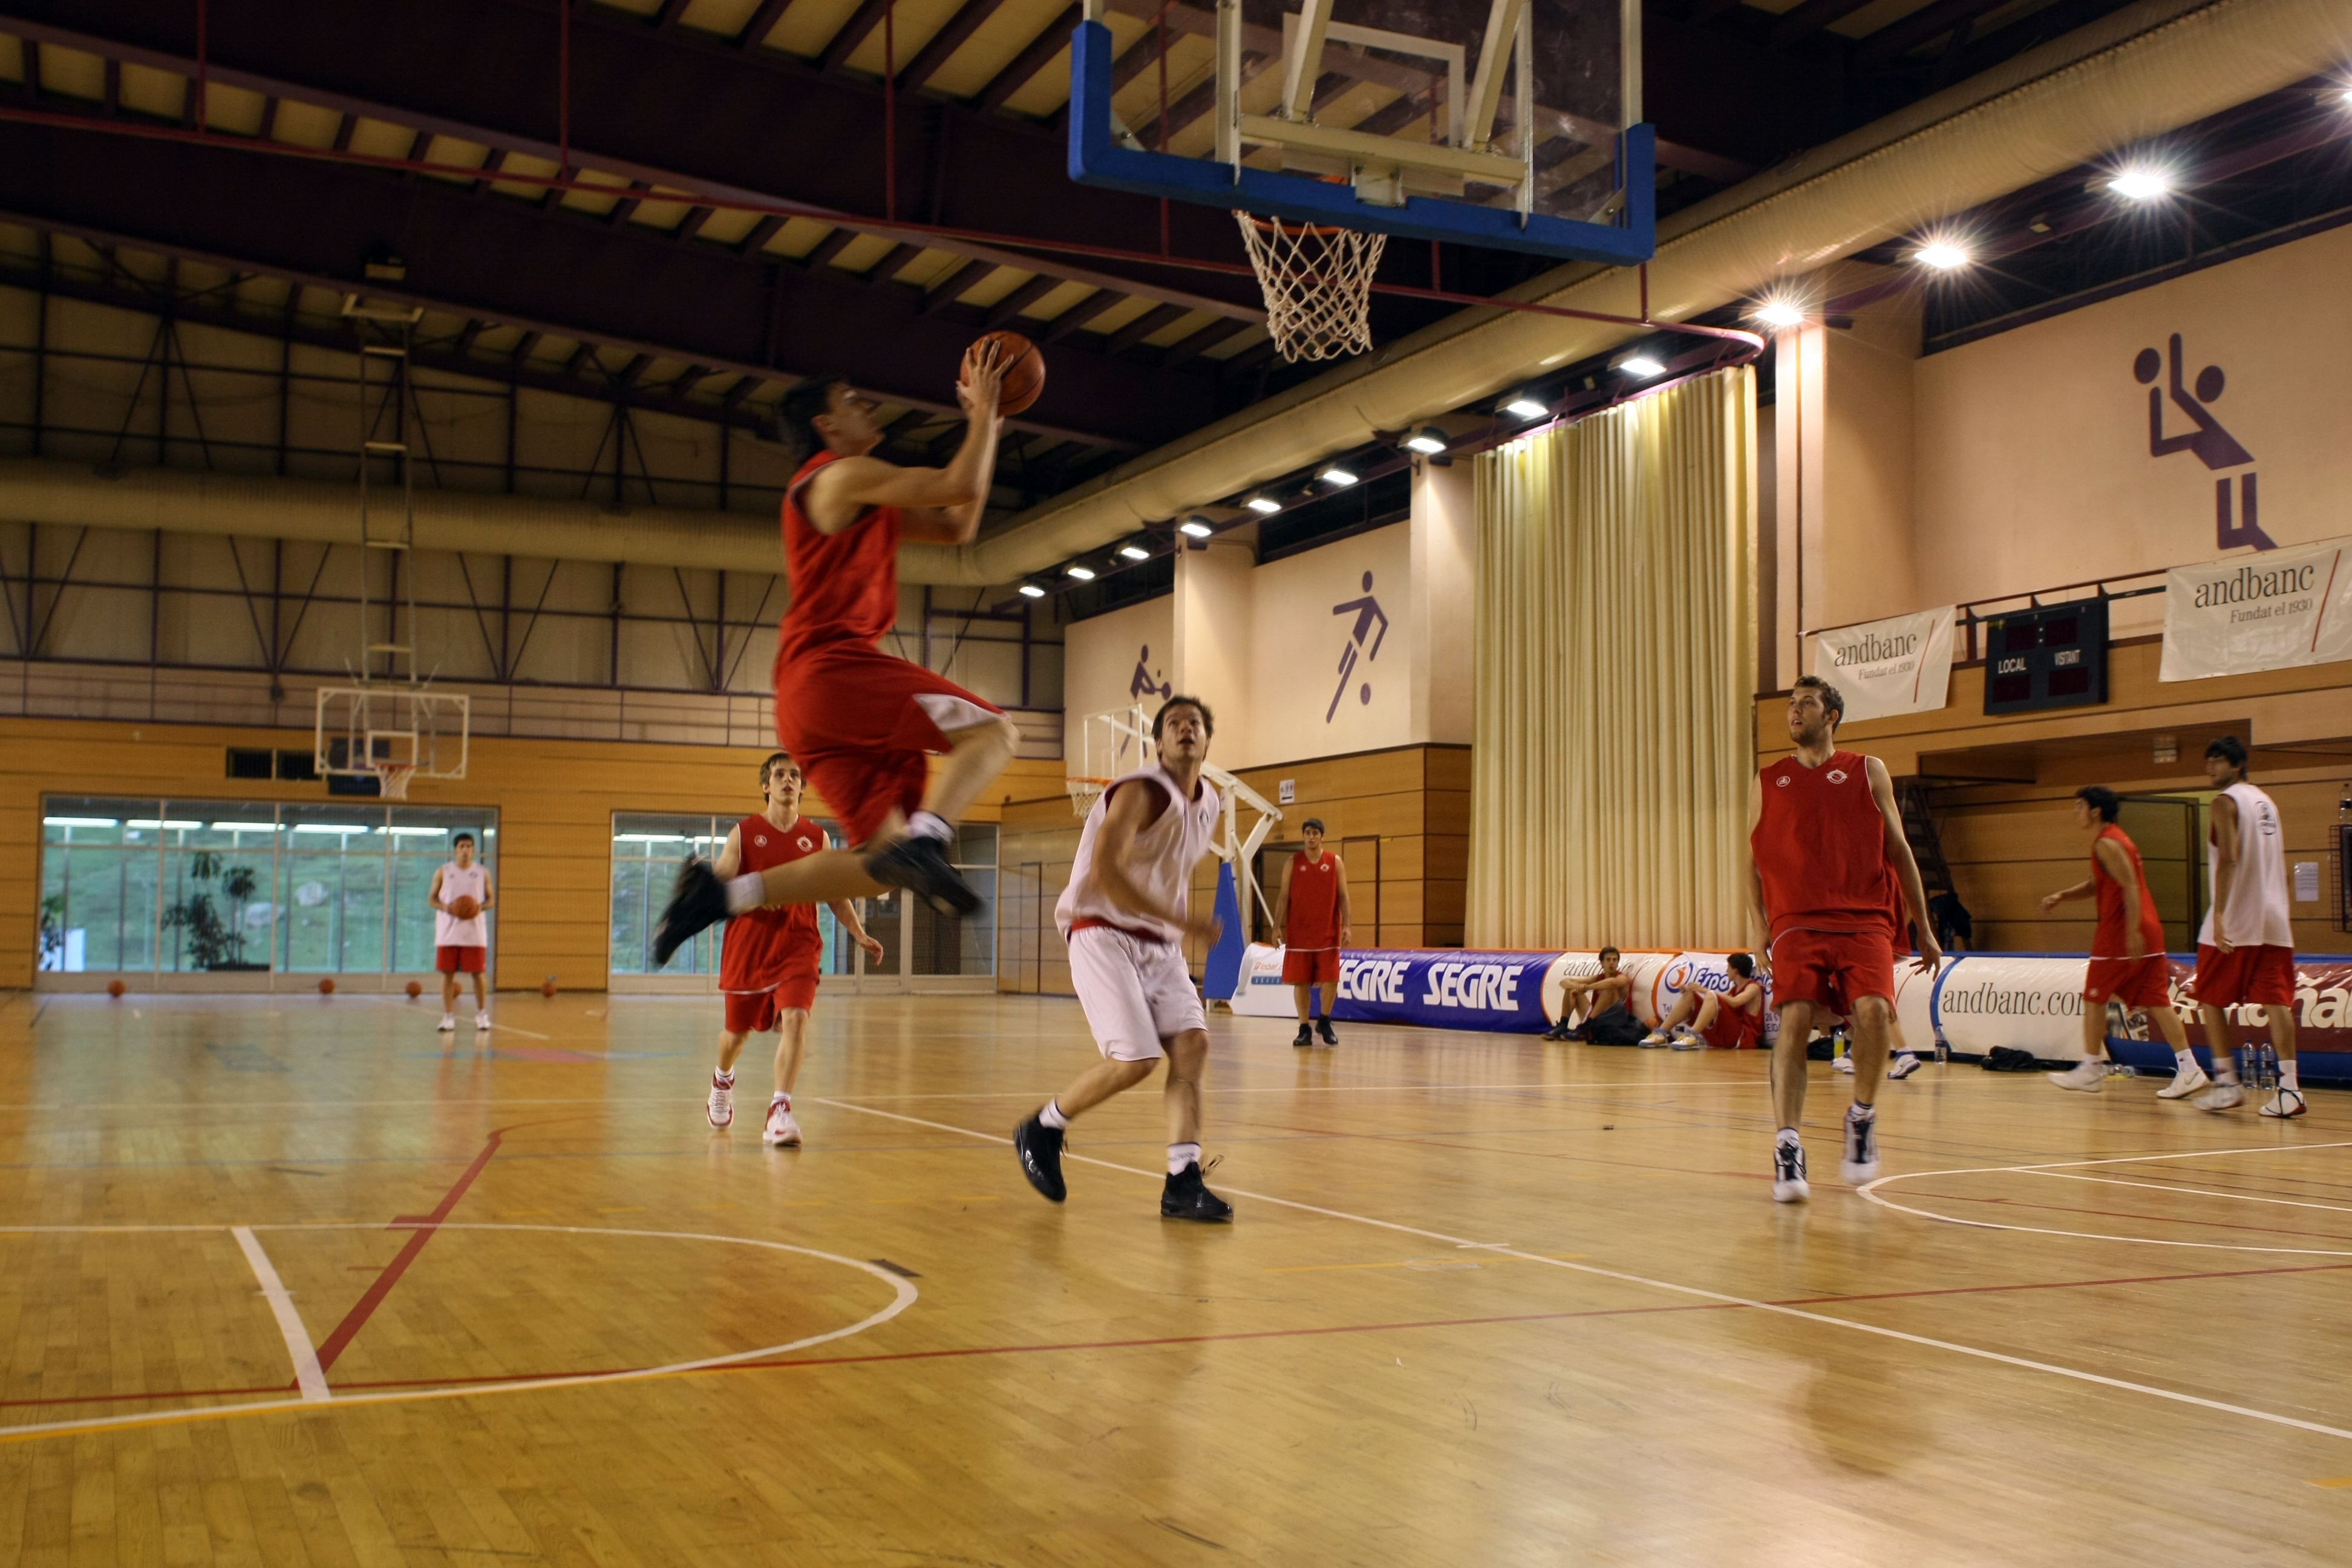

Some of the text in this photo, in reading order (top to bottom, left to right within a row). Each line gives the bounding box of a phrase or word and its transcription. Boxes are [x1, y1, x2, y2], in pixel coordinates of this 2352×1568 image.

[2195, 565, 2314, 608] andbanc
[2230, 598, 2314, 624] Fundat el 1930
[1834, 633, 1917, 667] andbanc
[1858, 660, 1915, 681] Fundat el 1930
[1998, 657, 2027, 675] LOCAL
[1337, 959, 1524, 1011] EGRE SEGRE
